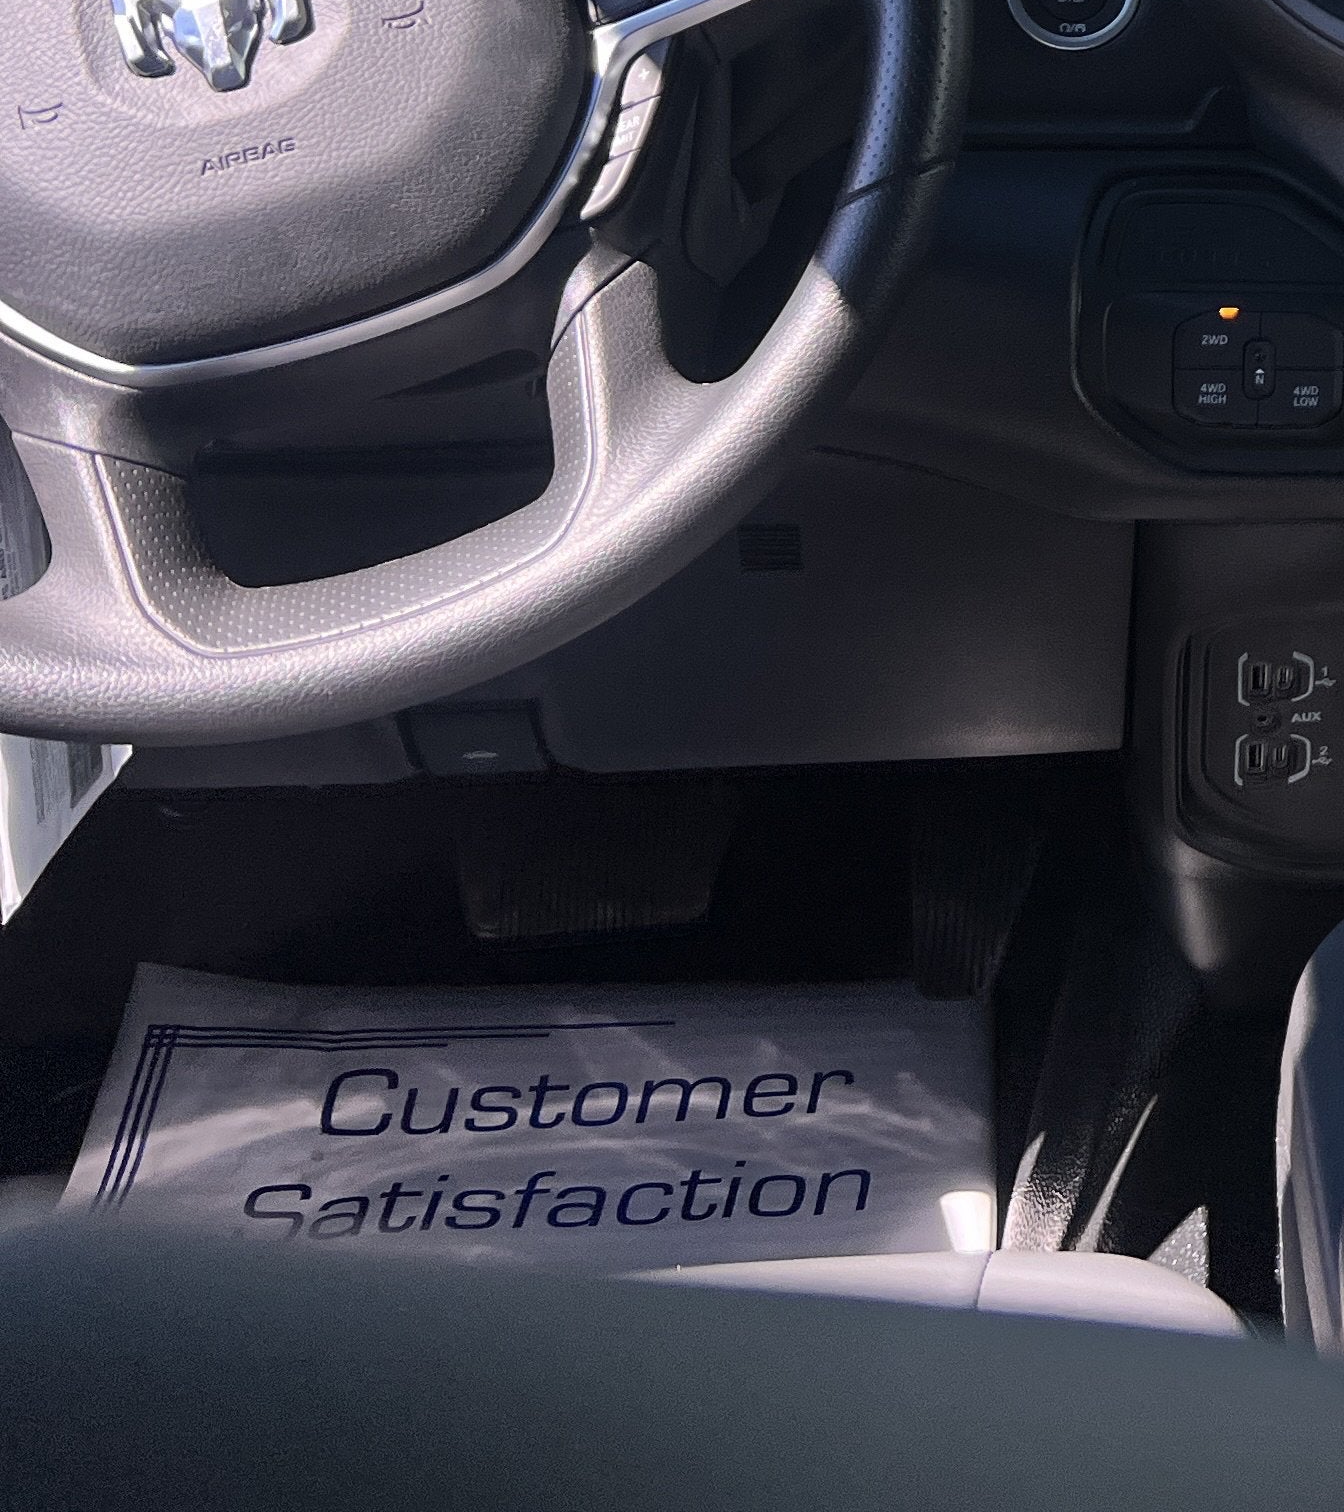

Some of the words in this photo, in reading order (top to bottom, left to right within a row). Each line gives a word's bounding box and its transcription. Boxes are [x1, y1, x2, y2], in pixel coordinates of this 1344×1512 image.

[1201, 334, 1229, 345] 2WD
[1255, 375, 1265, 384] N
[1200, 383, 1227, 393] 4WD
[1293, 385, 1320, 396] 4WD
[1198, 394, 1227, 404] HIGH
[1293, 396, 1320, 407] LOW
[1291, 711, 1322, 723] AUX
[318, 1066, 854, 1138] Customer
[243, 1161, 872, 1241] Satisfaction
